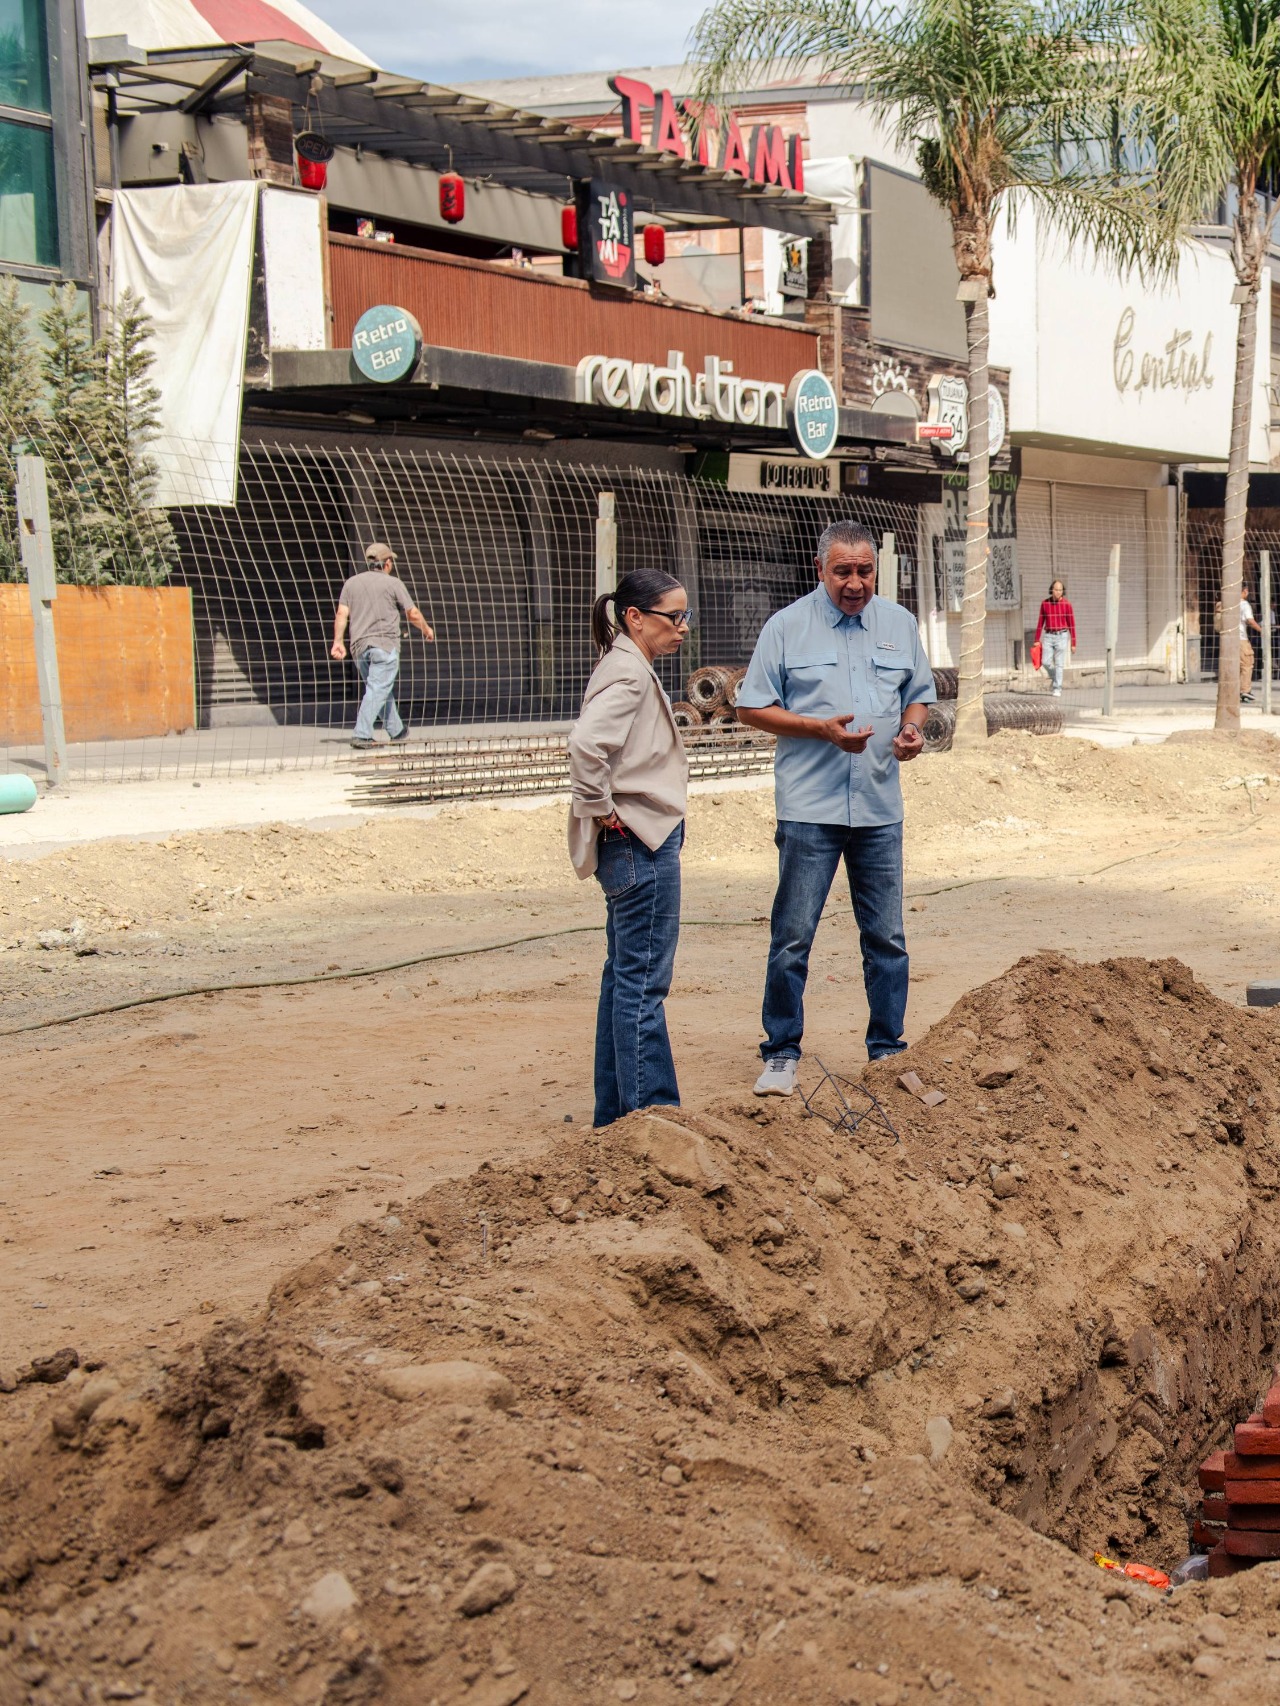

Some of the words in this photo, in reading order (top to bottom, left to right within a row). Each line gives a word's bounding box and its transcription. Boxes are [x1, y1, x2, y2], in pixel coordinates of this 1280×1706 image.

[608, 75, 804, 194] TATAMI
[354, 318, 408, 350] Retro
[371, 346, 402, 371] Bar
[800, 395, 833, 413] Retro
[807, 420, 828, 440] Bar
[1004, 474, 1017, 491] EN
[944, 489, 1013, 533] RETA
